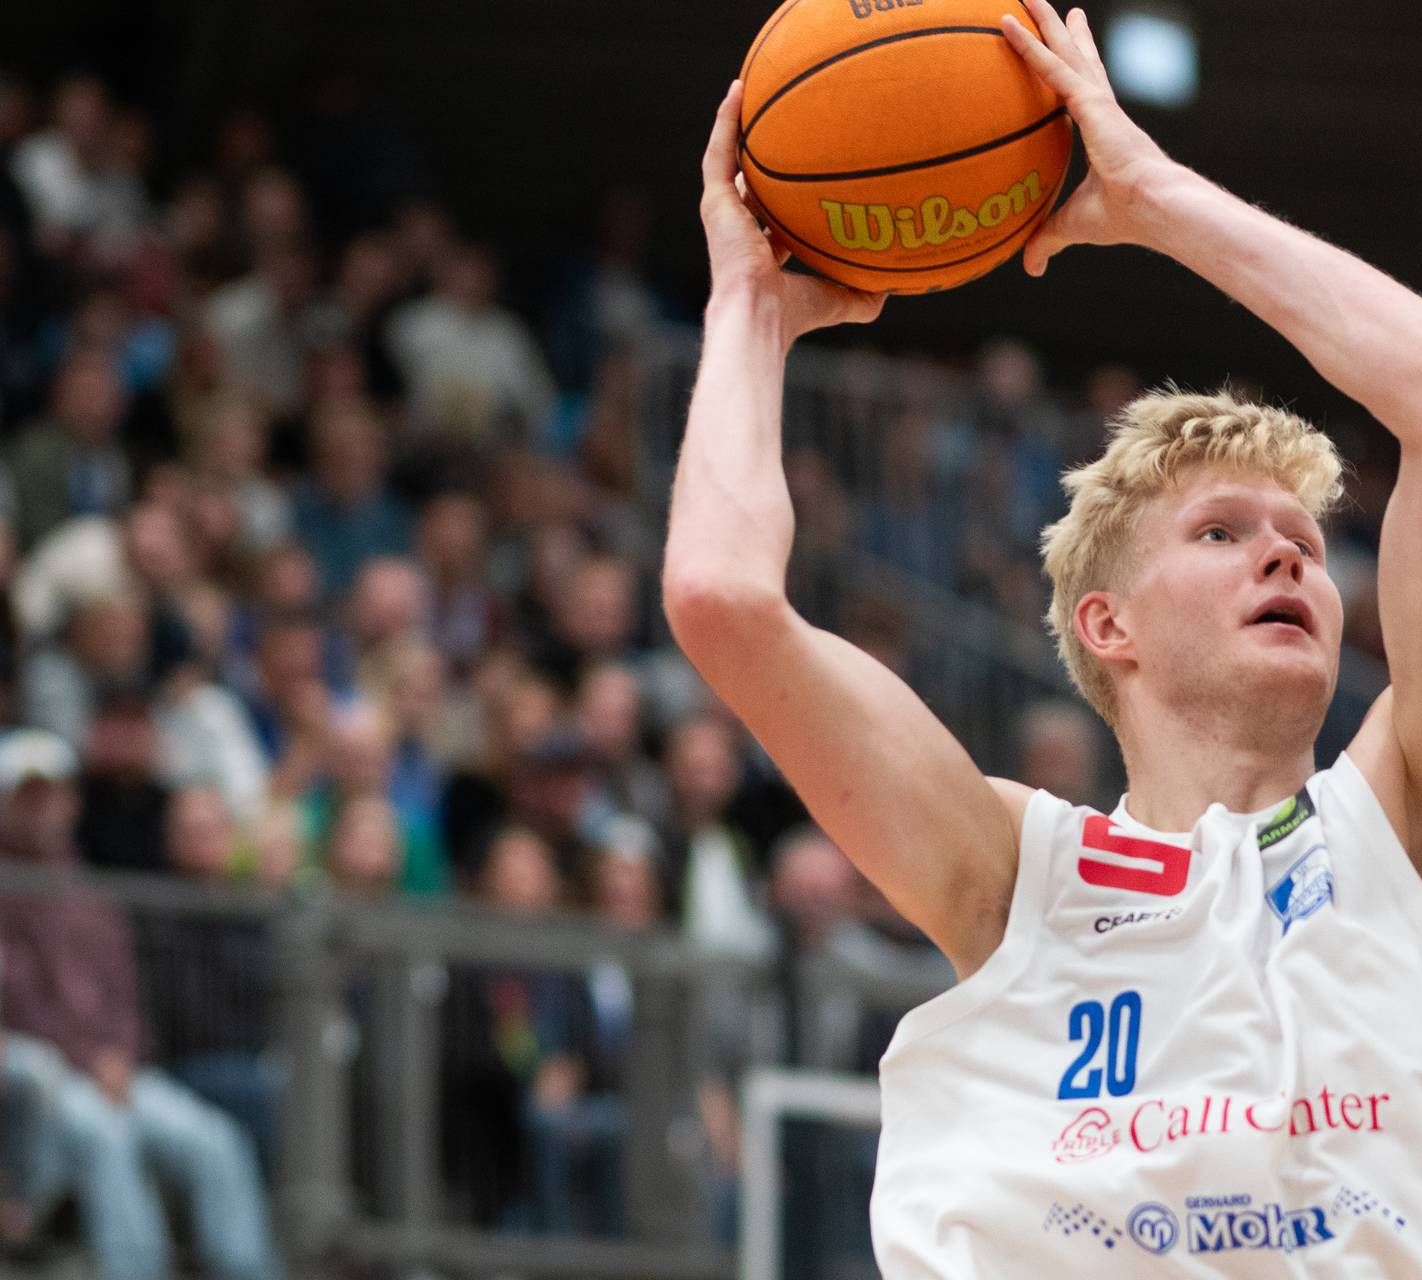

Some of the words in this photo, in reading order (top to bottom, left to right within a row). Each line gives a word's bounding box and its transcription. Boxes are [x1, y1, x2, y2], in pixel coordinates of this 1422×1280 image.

[819, 169, 1042, 251] Wilson
[1058, 989, 1142, 1101] 20
[1130, 1095, 1232, 1153] Call
[1245, 1083, 1391, 1137] Cnter
